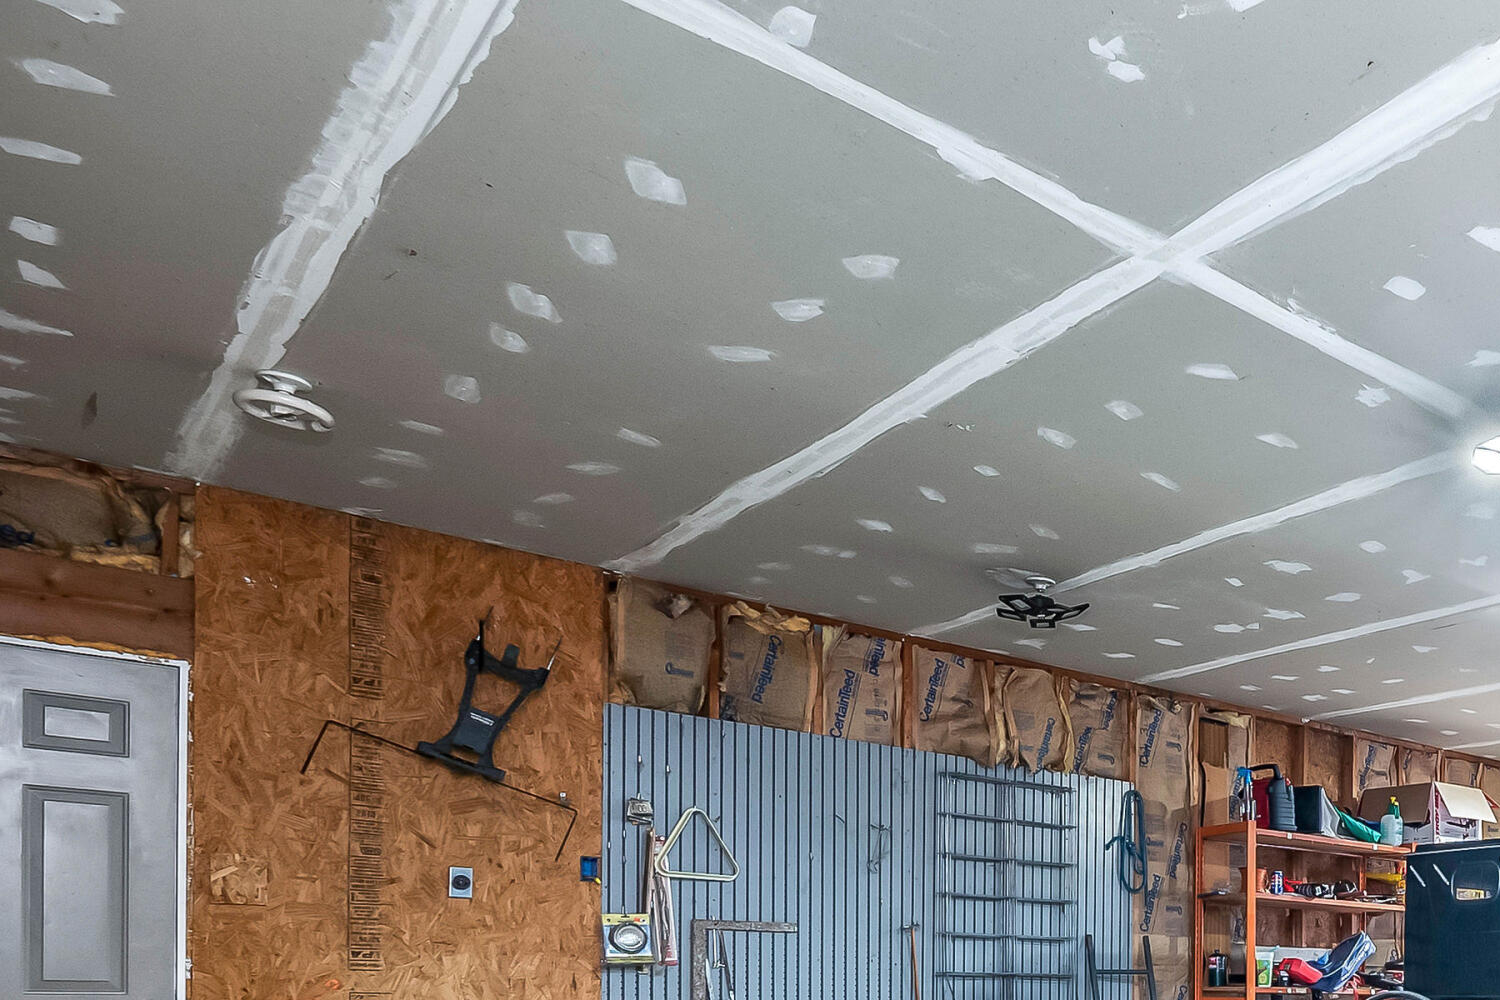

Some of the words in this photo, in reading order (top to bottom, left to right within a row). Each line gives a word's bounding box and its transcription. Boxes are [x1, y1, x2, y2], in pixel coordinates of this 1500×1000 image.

[752, 634, 782, 704] CertainTeed
[919, 657, 945, 722] CertainTeed
[829, 668, 856, 738] CertainTeed
[1140, 873, 1162, 932] CertainTeed
